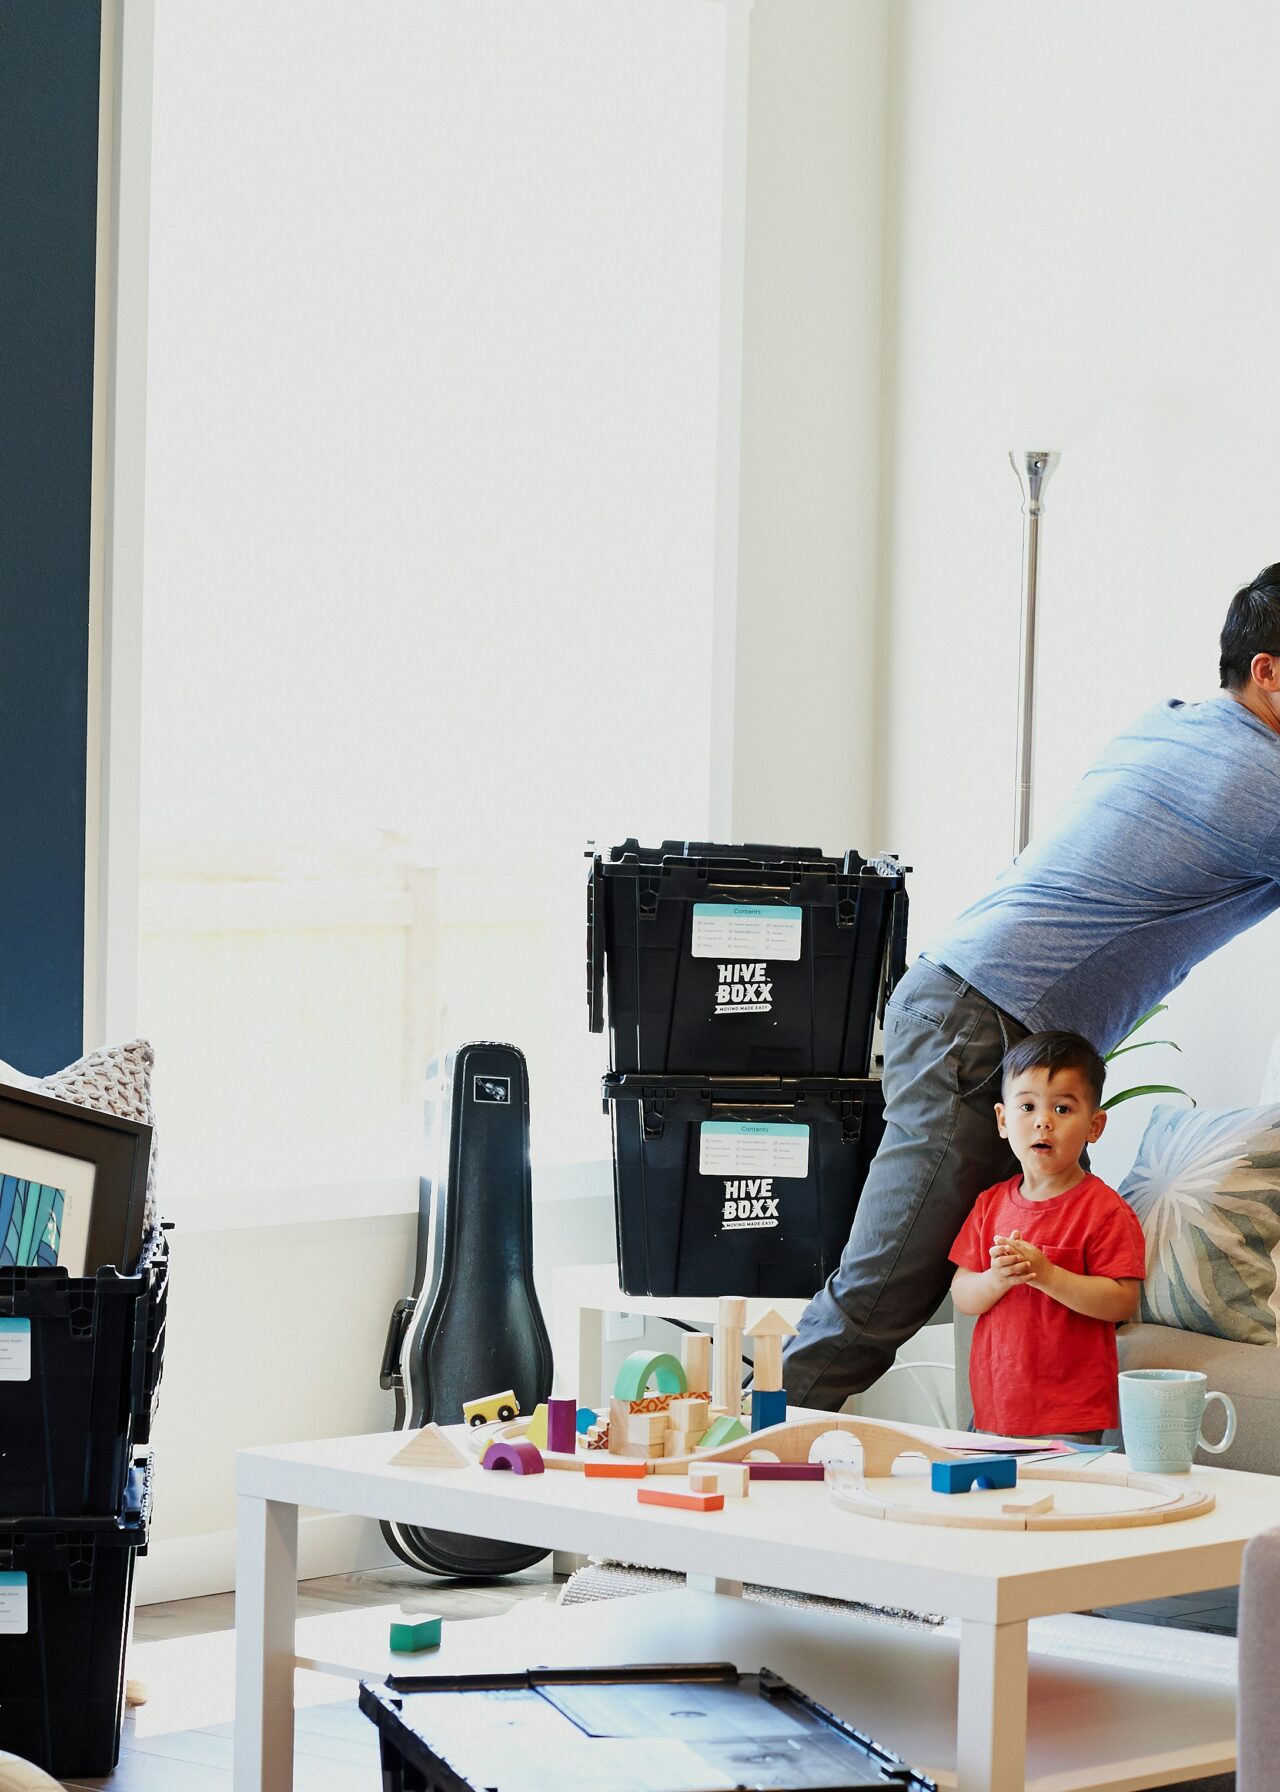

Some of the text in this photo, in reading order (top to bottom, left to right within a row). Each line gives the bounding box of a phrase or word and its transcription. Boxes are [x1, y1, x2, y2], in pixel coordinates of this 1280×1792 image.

[716, 963, 767, 983] HIVE
[714, 983, 773, 1003] BOXX
[723, 1178, 773, 1199] HIVE
[721, 1198, 780, 1220] BOXX
